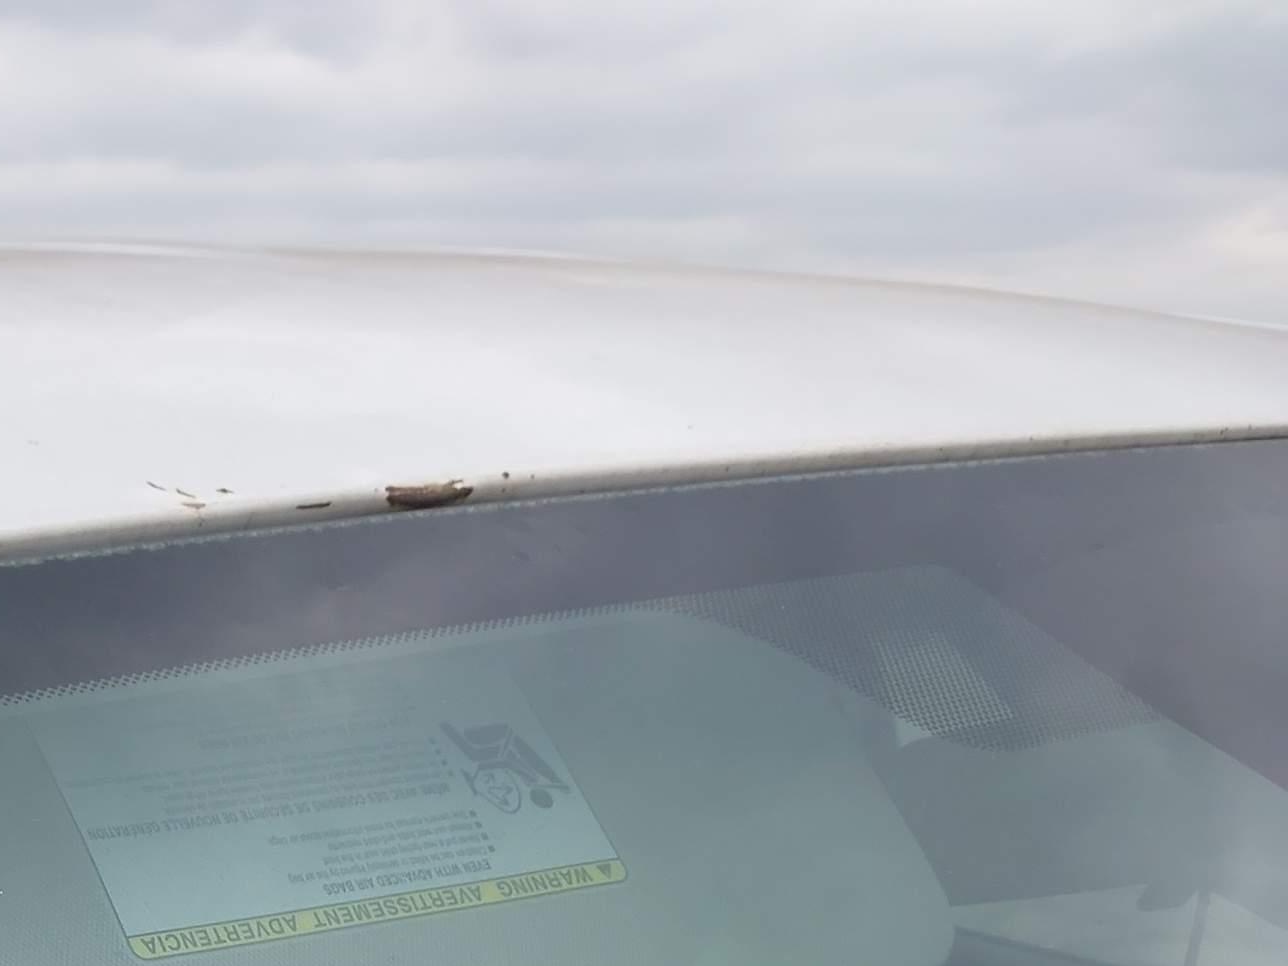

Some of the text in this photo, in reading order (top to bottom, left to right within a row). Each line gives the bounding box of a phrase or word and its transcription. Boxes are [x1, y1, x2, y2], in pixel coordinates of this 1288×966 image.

[433, 864, 462, 876] WITH
[461, 860, 491, 872] EVEN
[321, 881, 355, 894] BAGS
[355, 878, 375, 889] AIR
[140, 867, 593, 955] WARNING AVERTISSEMENT ADVERTENCIA
